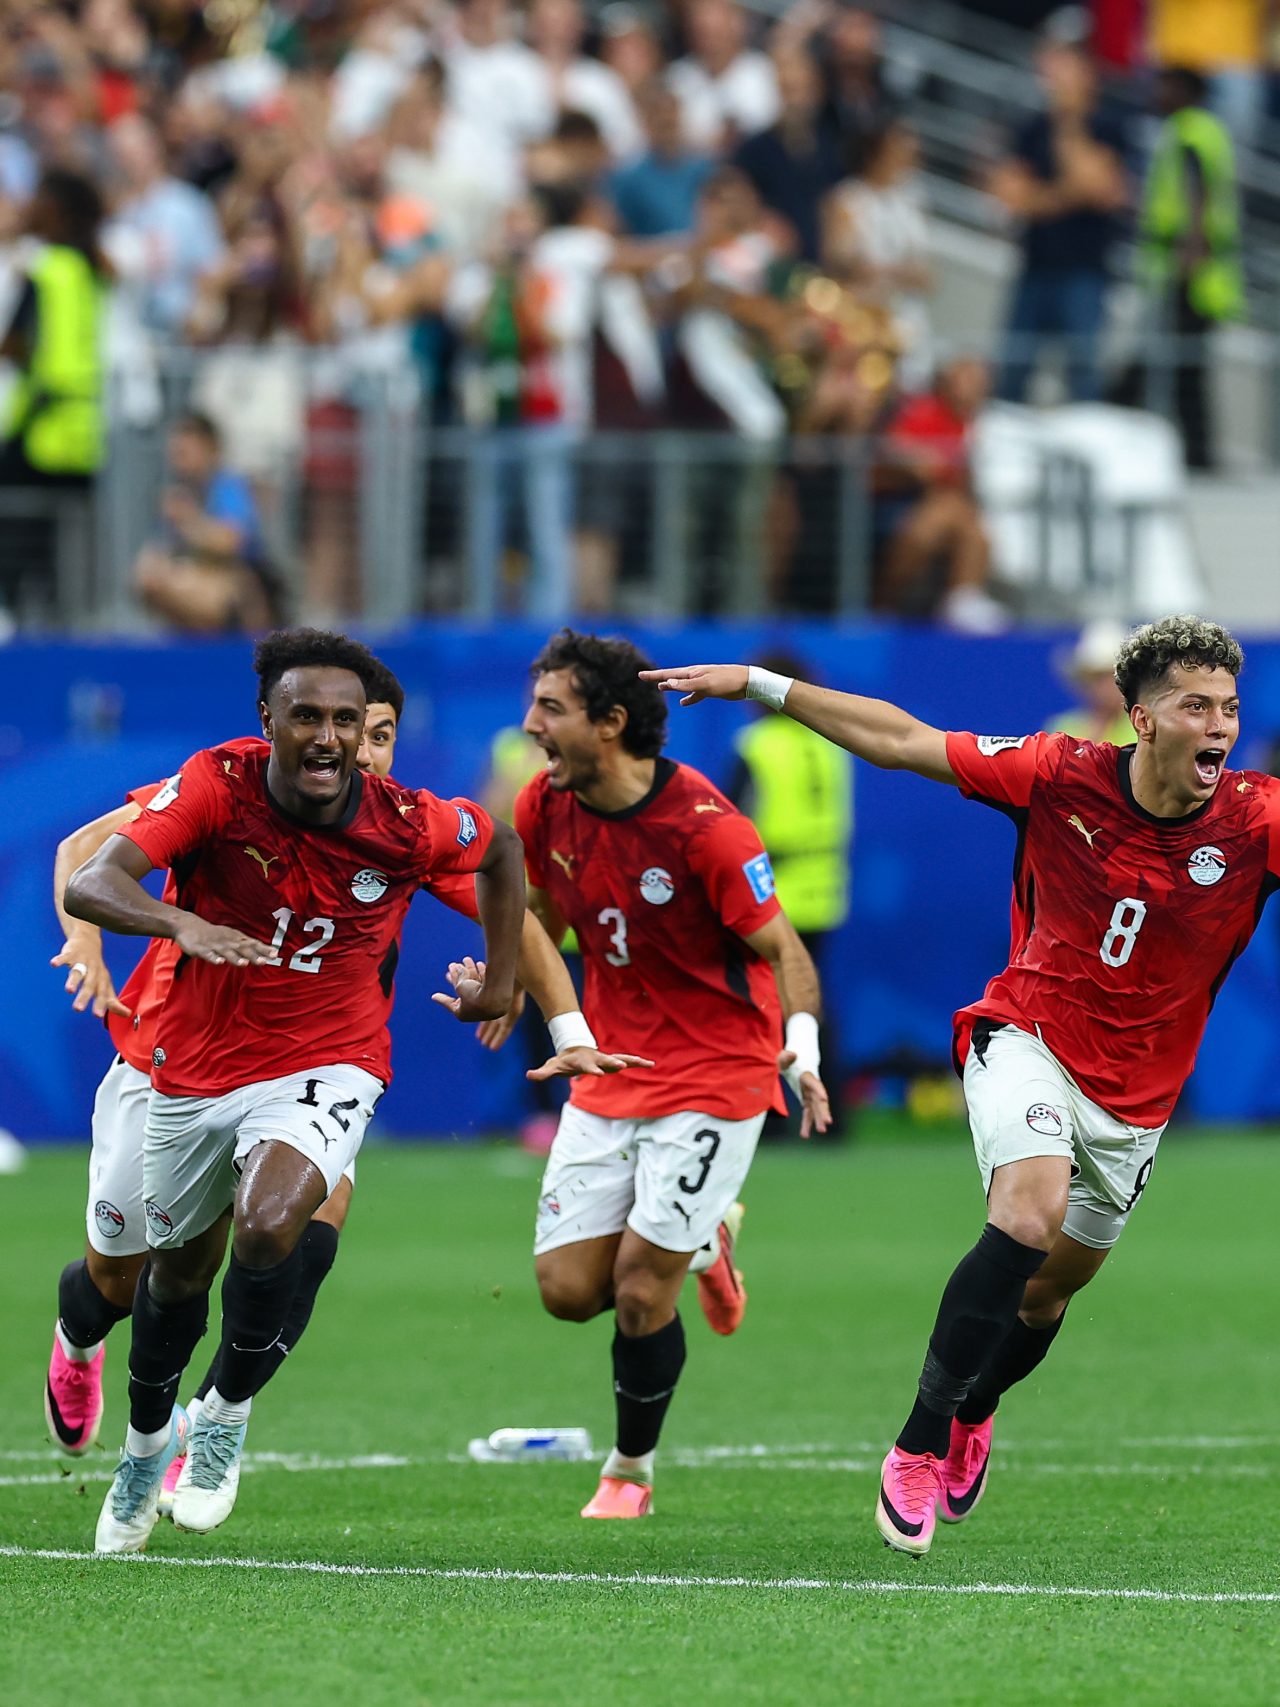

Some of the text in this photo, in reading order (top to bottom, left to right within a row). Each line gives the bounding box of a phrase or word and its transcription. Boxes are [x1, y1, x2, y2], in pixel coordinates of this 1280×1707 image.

[265, 907, 335, 974] 12
[597, 907, 631, 968] 3
[1099, 897, 1147, 968] 8
[296, 1078, 360, 1133] 12
[679, 1129, 721, 1195] 3
